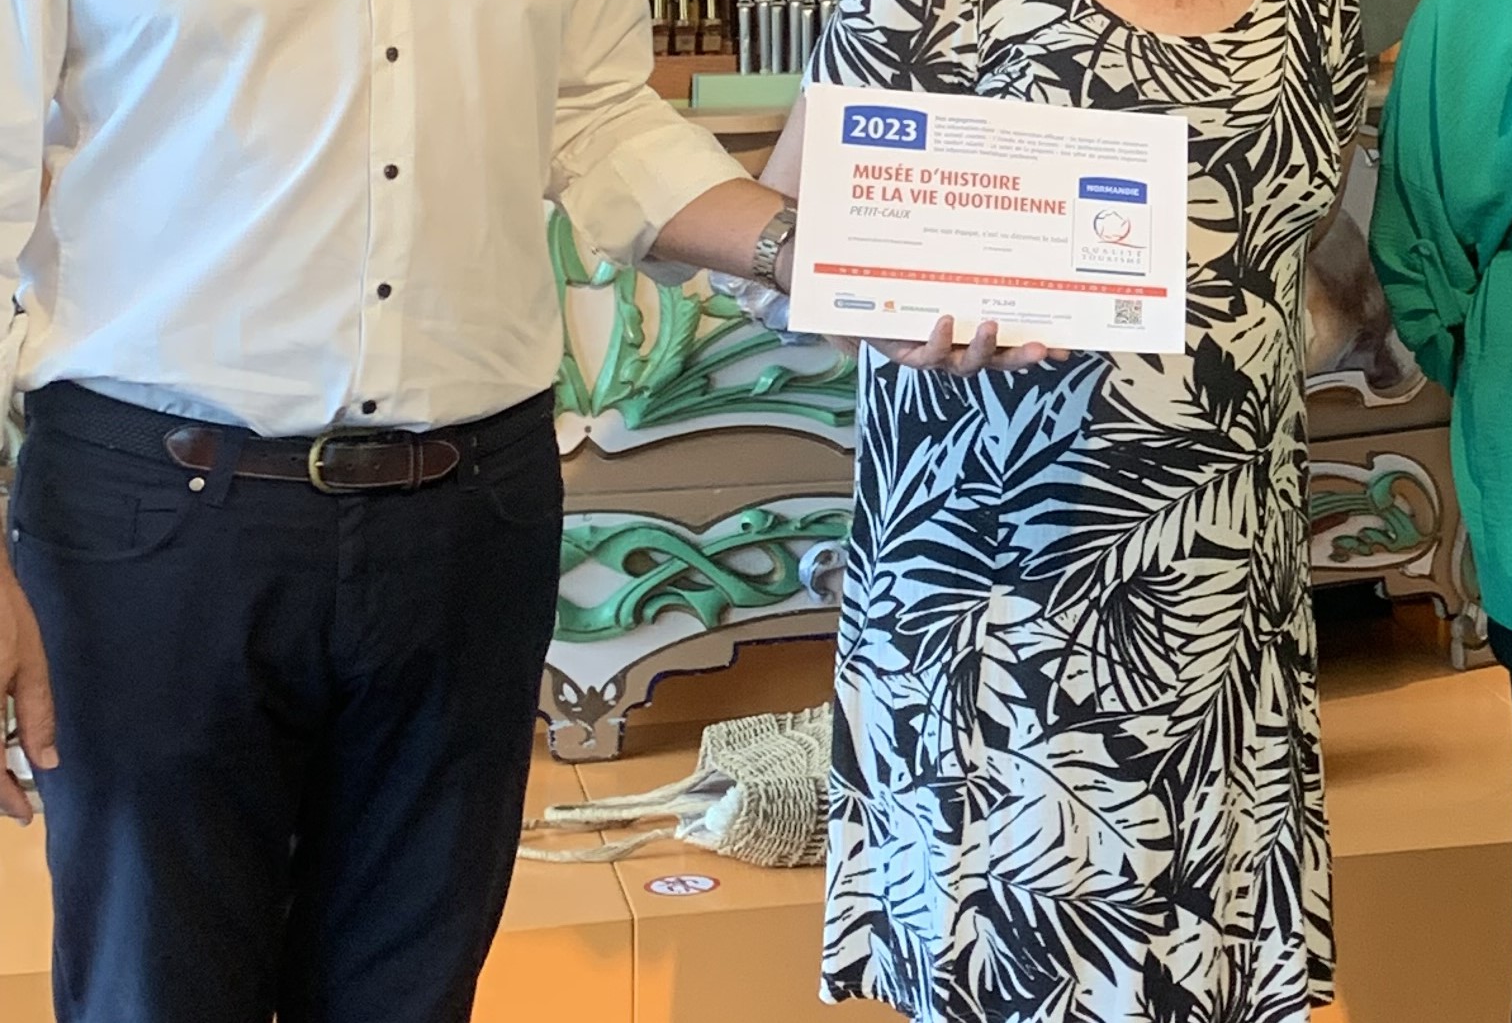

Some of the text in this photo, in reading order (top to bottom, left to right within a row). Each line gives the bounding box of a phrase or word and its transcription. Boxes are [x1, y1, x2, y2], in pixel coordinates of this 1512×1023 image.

[850, 114, 917, 142] 2023
[853, 163, 1021, 191] MUSÉE D'HISTOIRE
[1086, 184, 1140, 197] NORMANDIE
[852, 184, 1067, 215] DE LA VIE QUOTIDIENNE
